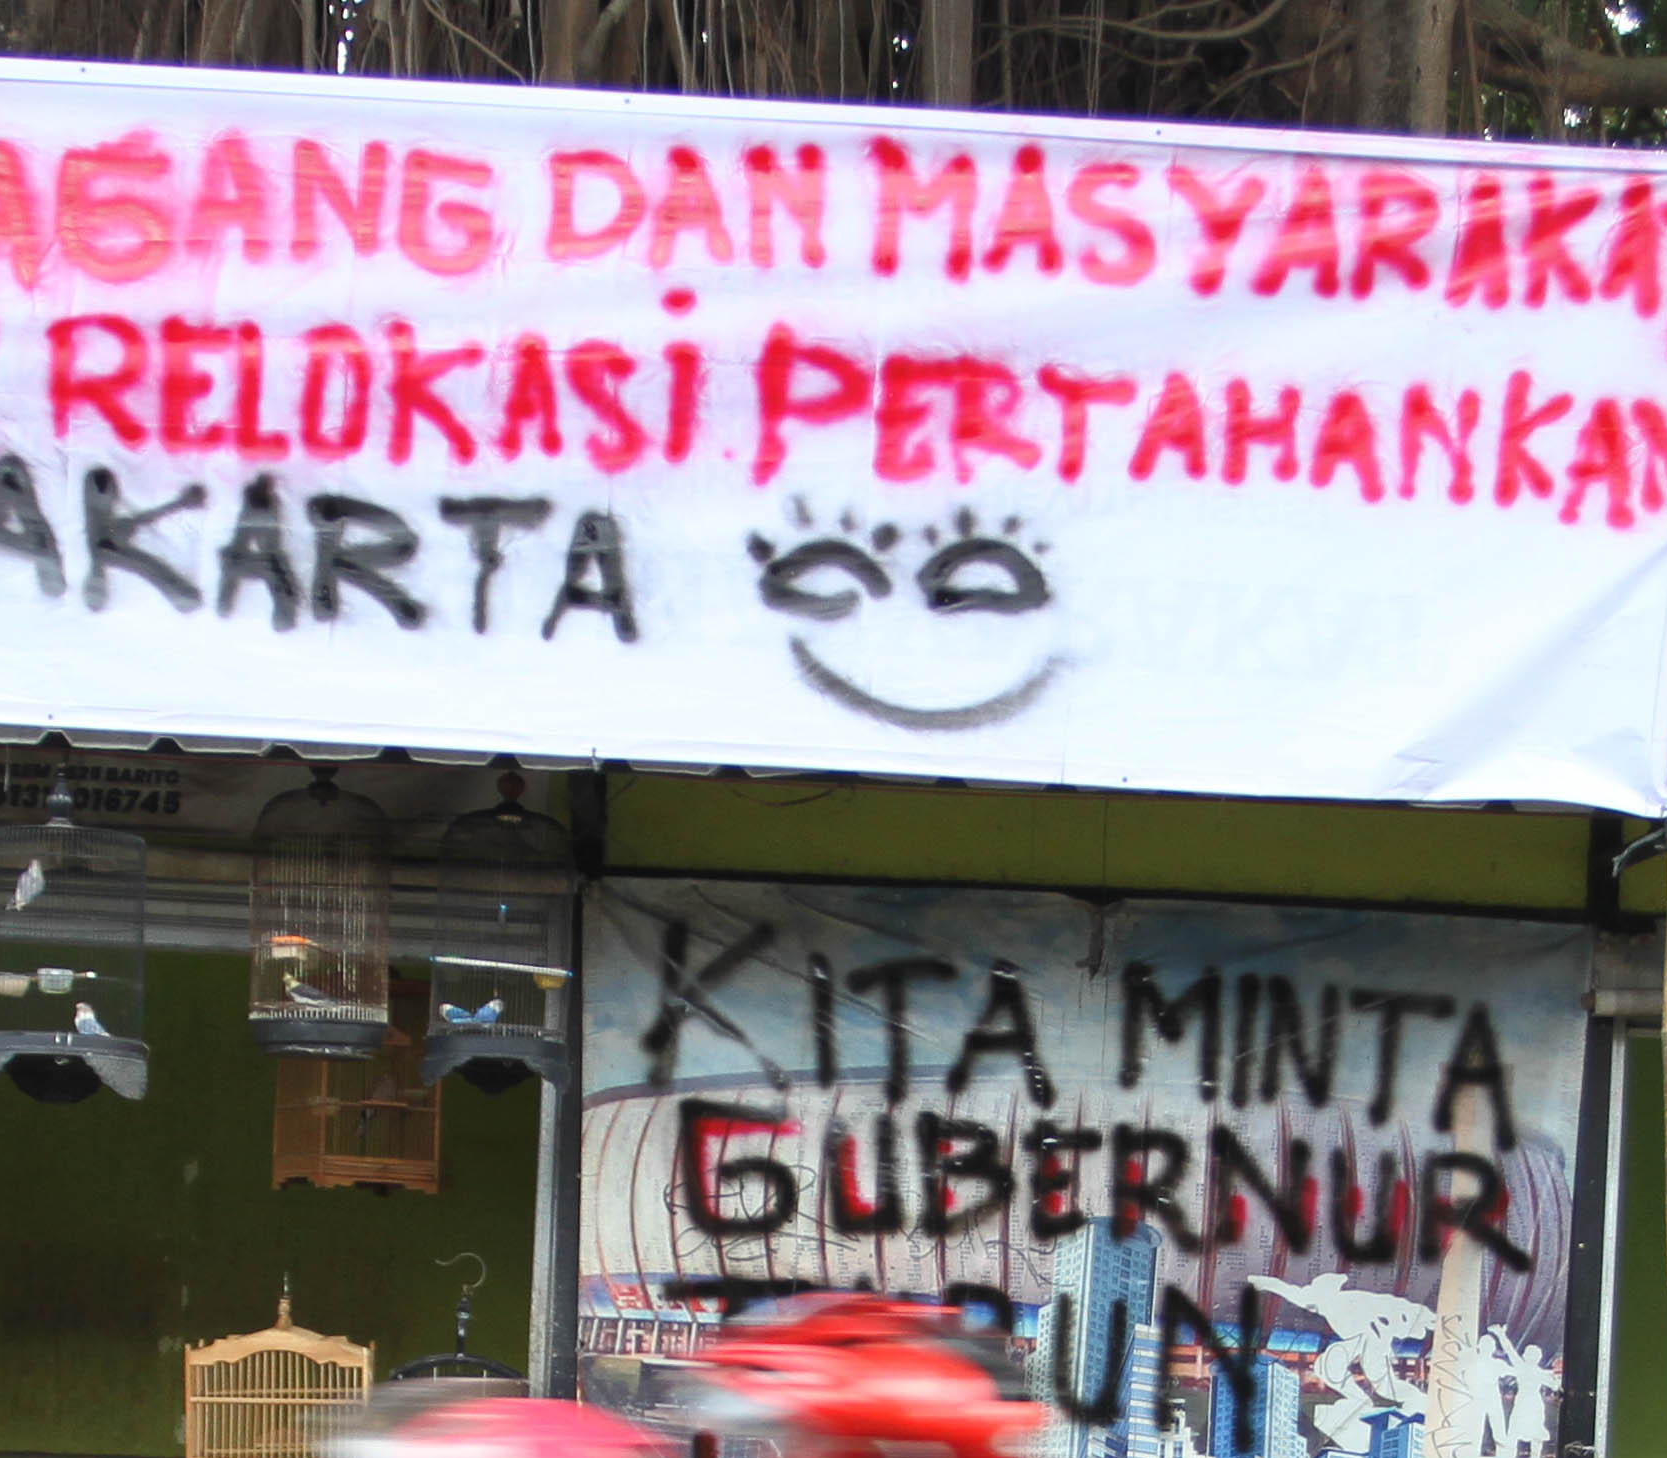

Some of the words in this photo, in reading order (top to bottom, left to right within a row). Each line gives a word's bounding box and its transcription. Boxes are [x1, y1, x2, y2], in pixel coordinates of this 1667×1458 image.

[543, 140, 827, 270] DAN
[106, 767, 180, 784] BARITO
[645, 920, 1055, 1109] KITA
[1119, 960, 1515, 1150] MINTA
[677, 1095, 1532, 1271] GUBERNUR
